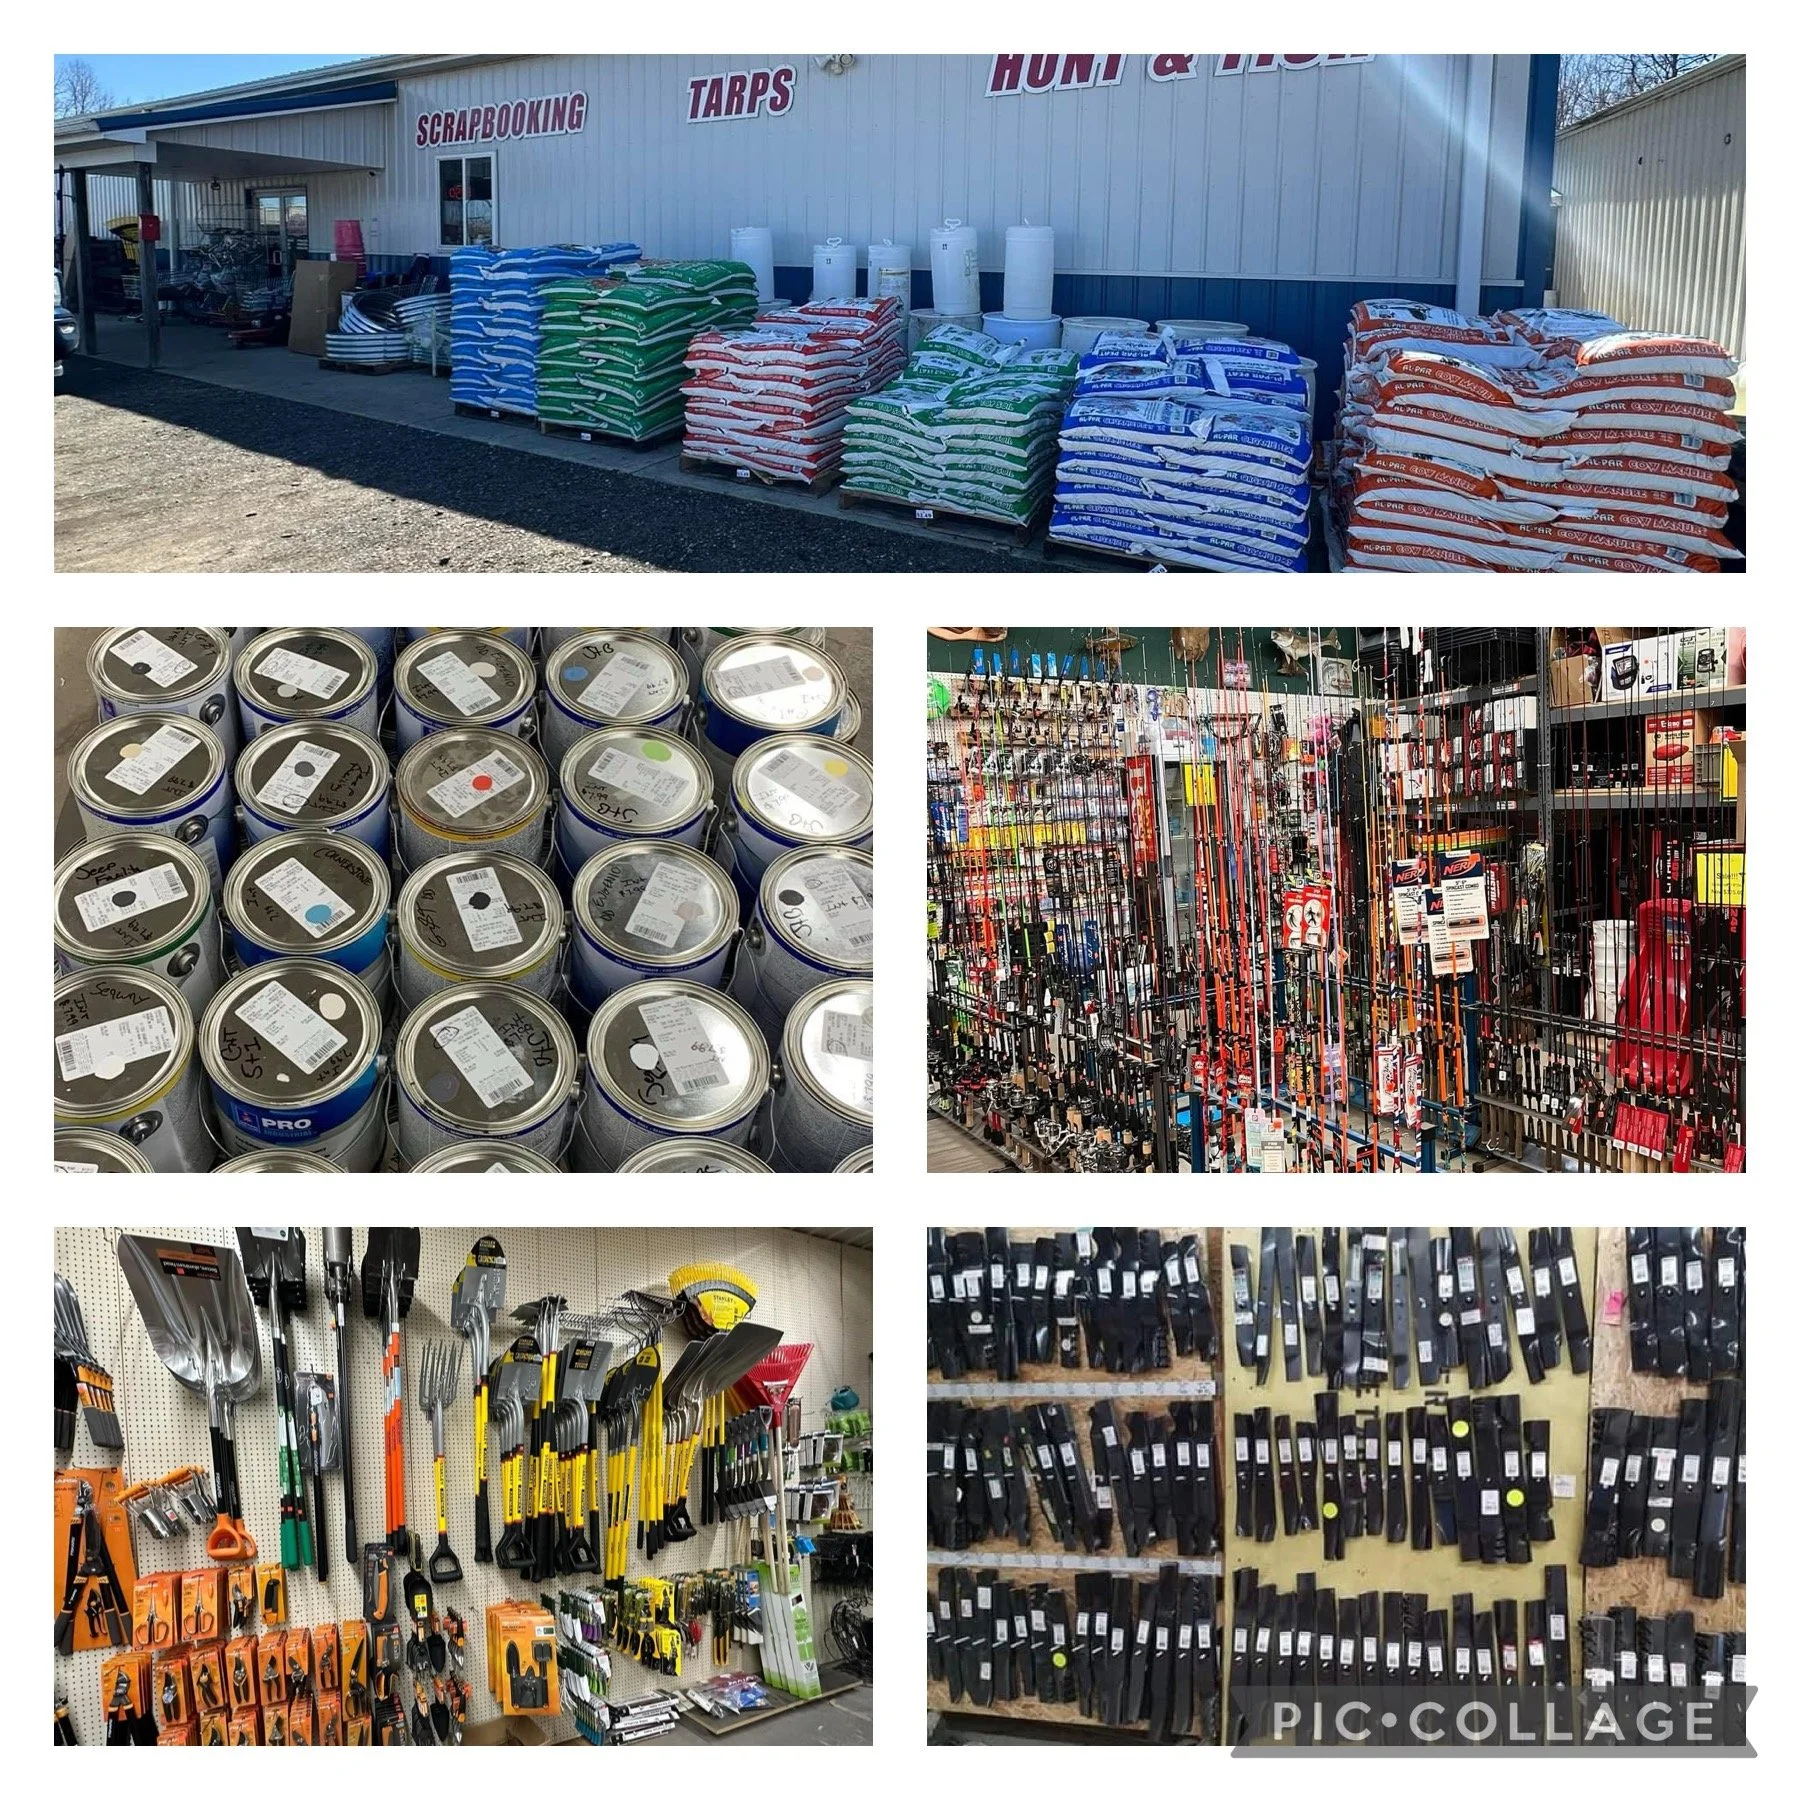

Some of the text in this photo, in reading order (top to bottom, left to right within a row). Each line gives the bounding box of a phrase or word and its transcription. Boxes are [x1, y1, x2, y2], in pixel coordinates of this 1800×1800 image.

[990, 54, 1127, 92] HUNT
[1153, 54, 1196, 77] &
[689, 69, 793, 120] TARPS
[416, 93, 586, 146] SCRAPBOOKING
[1629, 460, 1659, 472] COW
[1662, 464, 1713, 481] MANURE
[261, 1118, 312, 1130] PRO
[713, 1294, 734, 1303] STANLEY
